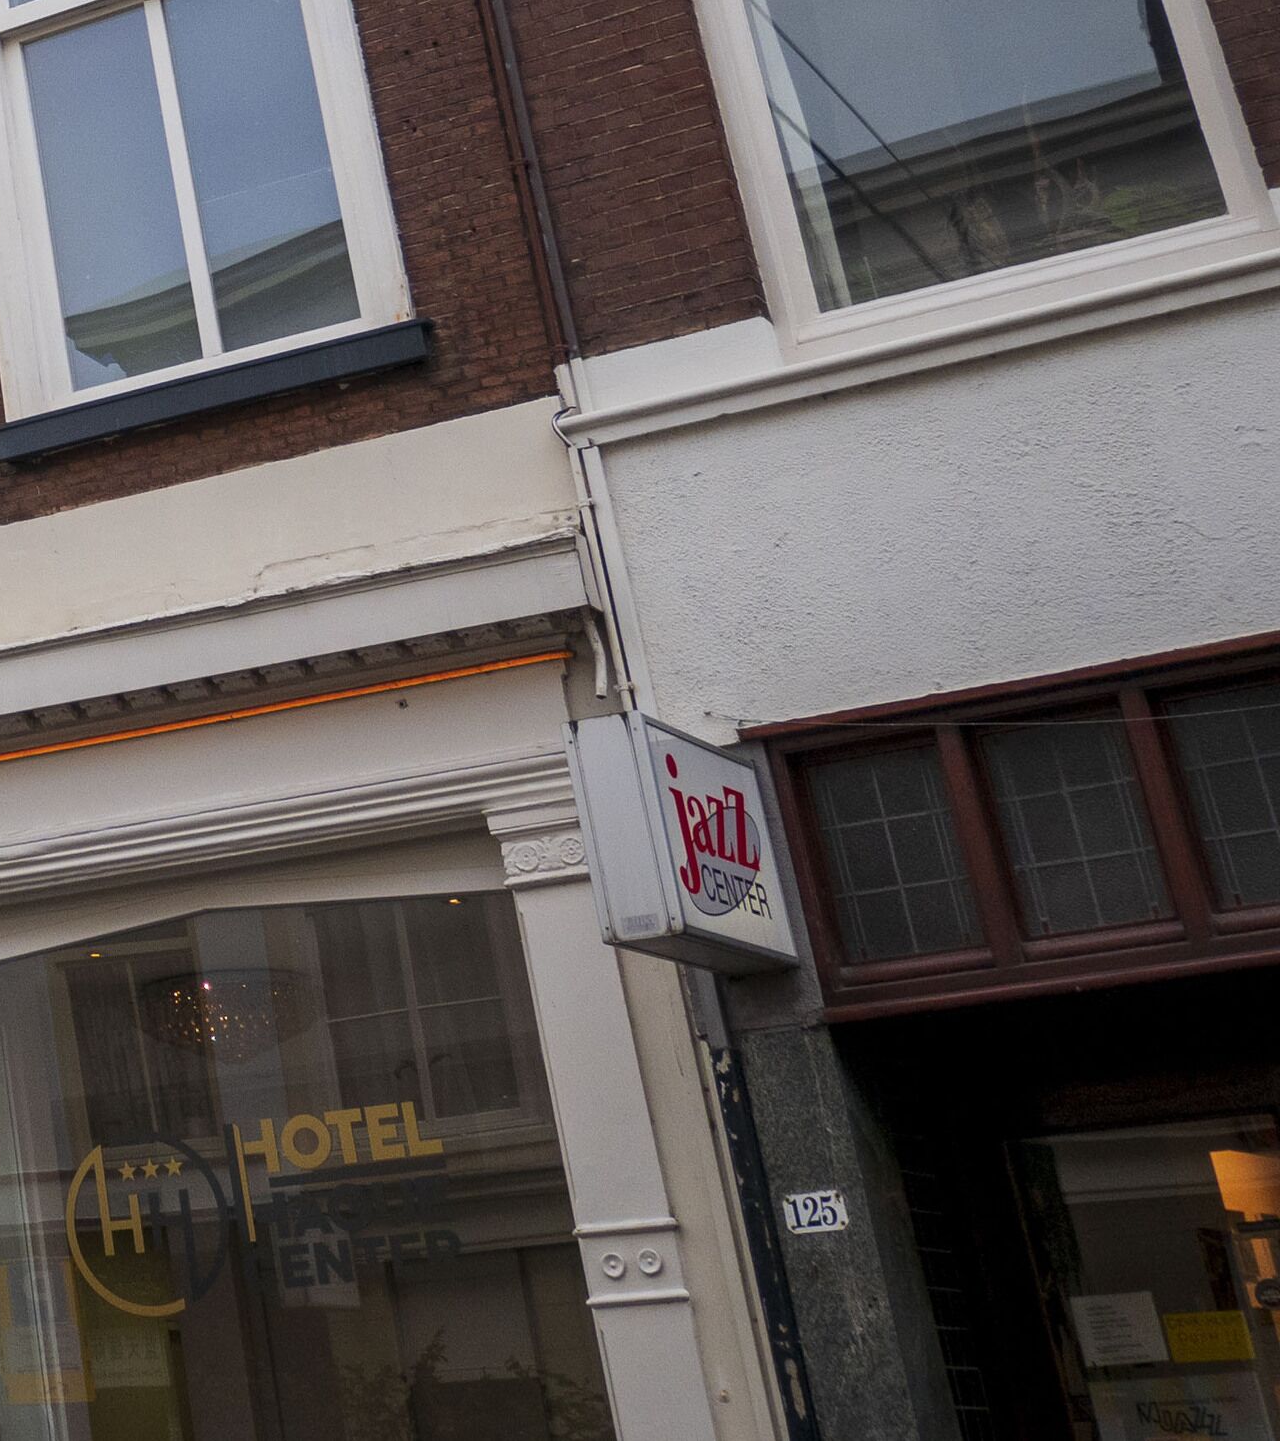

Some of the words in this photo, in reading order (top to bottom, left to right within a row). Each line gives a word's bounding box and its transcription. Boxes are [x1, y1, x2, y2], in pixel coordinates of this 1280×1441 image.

[701, 863, 773, 930] CENTER
[224, 1101, 444, 1174] HOTEL
[787, 1195, 838, 1229] 125
